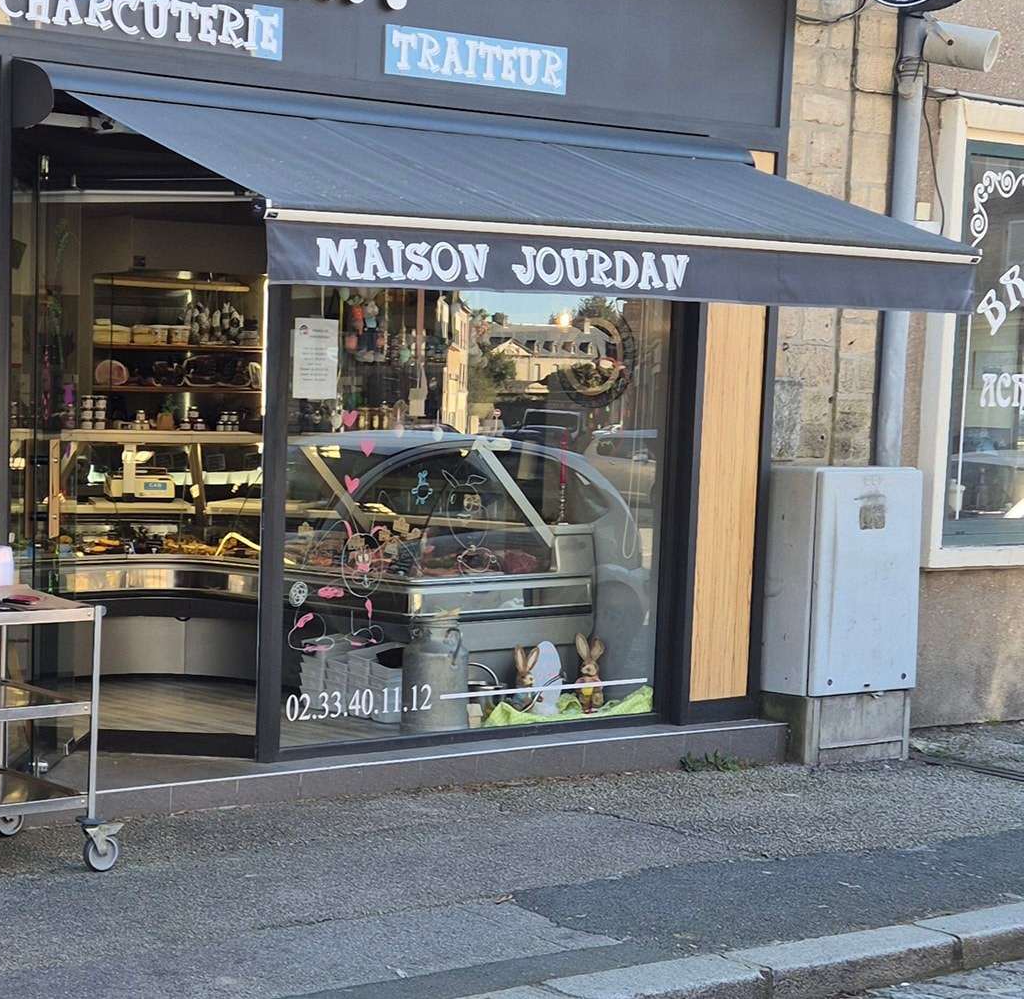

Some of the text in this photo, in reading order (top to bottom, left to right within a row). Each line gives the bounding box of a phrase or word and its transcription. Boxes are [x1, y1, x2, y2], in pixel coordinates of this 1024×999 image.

[391, 30, 563, 88] TRAITEUR
[316, 237, 690, 291] MAISON JOURDAN
[285, 683, 433, 722] 02.33.40.11.12
